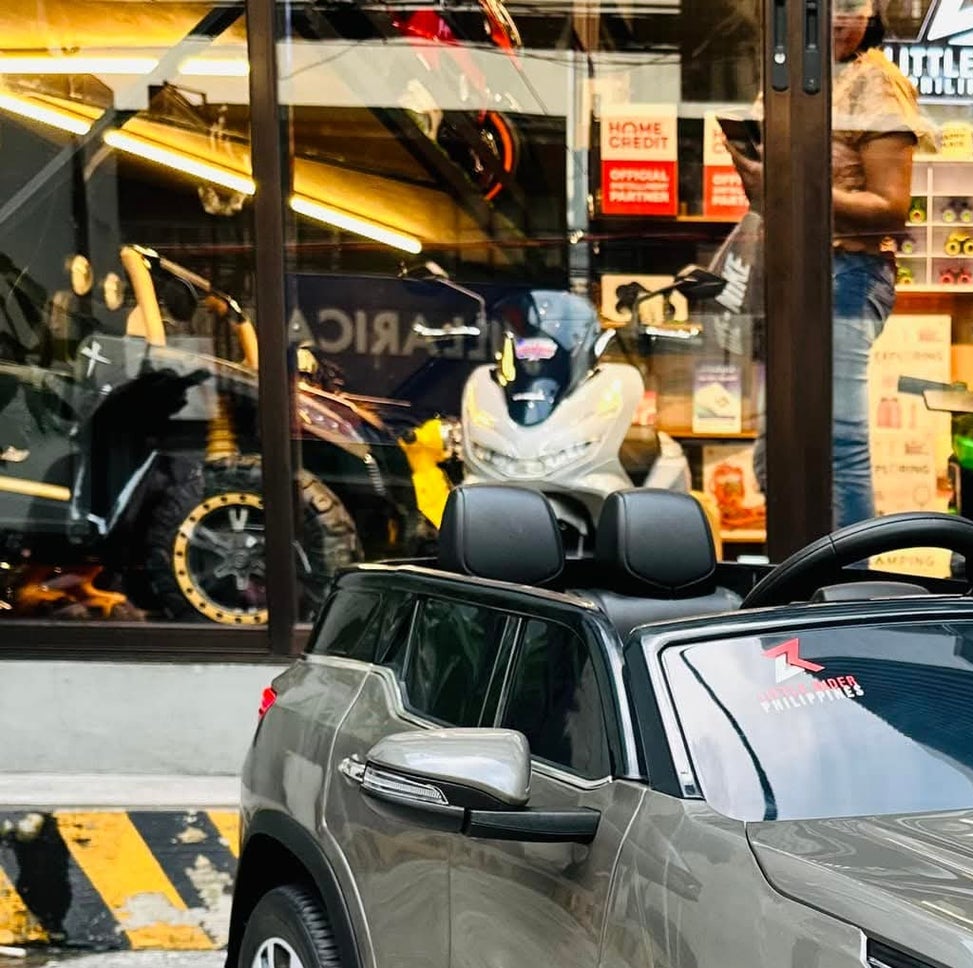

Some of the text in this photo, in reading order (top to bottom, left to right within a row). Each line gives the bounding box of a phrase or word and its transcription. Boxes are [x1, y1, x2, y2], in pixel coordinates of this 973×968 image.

[608, 121, 662, 134] HOME
[608, 136, 669, 149] CREDIT
[761, 684, 865, 714] PHILIPPINES
